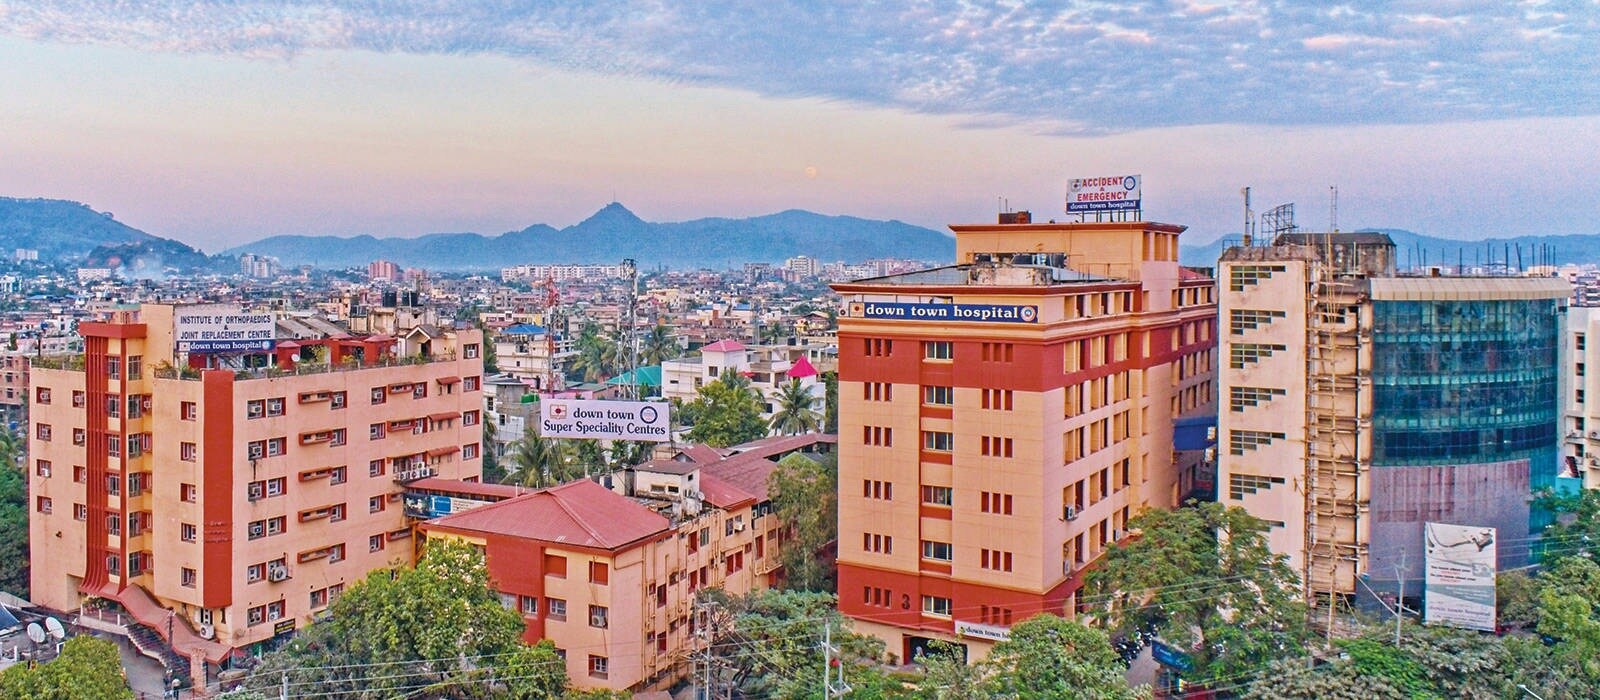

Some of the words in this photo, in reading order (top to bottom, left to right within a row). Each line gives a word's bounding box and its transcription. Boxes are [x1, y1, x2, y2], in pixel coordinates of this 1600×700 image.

[1082, 177, 1124, 187] ACCIDENT
[1077, 191, 1128, 201] EMERGENCY
[1108, 201, 1136, 209] hospital
[866, 304, 905, 316] down
[911, 306, 948, 317] town
[953, 306, 1019, 320] hospital
[180, 316, 212, 324] INSTITUTE
[215, 316, 223, 324] OF
[225, 315, 271, 324] ORTHOPAEDICS
[202, 331, 245, 339] REPLACEMENT
[248, 330, 271, 338] CENTRE
[190, 342, 211, 350] down
[232, 341, 262, 350] hospital
[573, 408, 603, 418] down
[607, 409, 634, 420] town
[544, 420, 573, 433] Super
[576, 421, 624, 435] Speciality
[627, 422, 666, 435] Centres
